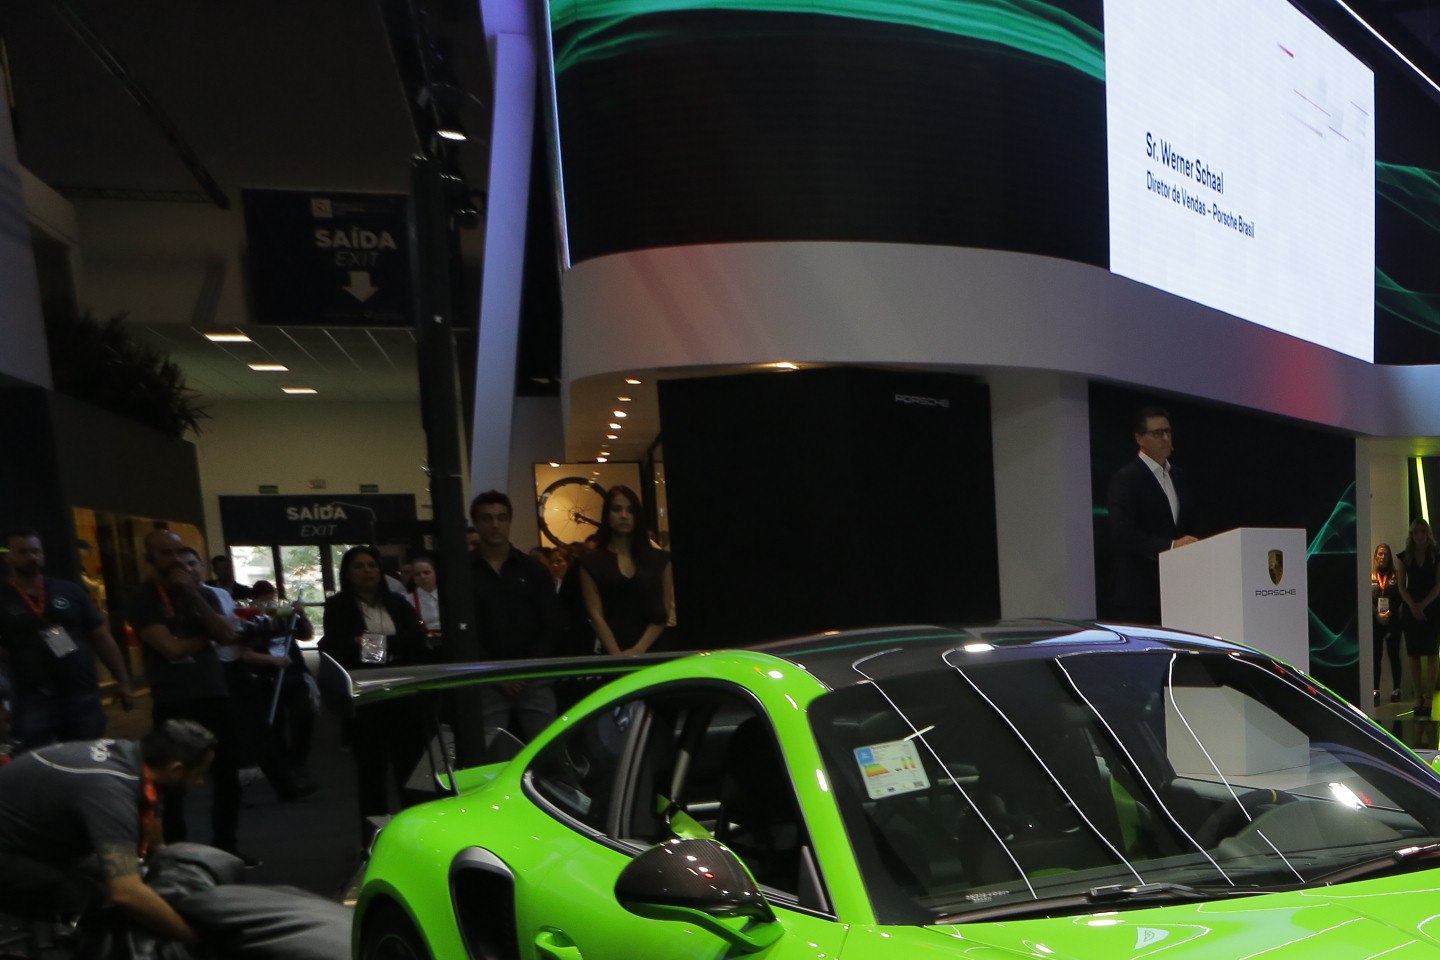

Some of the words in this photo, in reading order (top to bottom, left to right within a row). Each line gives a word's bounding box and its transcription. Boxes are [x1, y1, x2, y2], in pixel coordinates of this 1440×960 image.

[1146, 131, 1159, 162] Sr.
[1160, 138, 1194, 179] Werner
[1195, 158, 1224, 194] Schaal
[1146, 169, 1171, 200] Diretor
[1172, 184, 1181, 204] de
[1181, 187, 1206, 216] Vendas
[1212, 202, 1238, 231] Porsche
[1238, 214, 1255, 239] Brasil
[314, 225, 398, 250] SAÍDA
[334, 251, 381, 267] EXIT
[285, 503, 348, 521] SAÍDA
[300, 523, 338, 537] EXIT
[1255, 588, 1297, 597] PORSCHE
